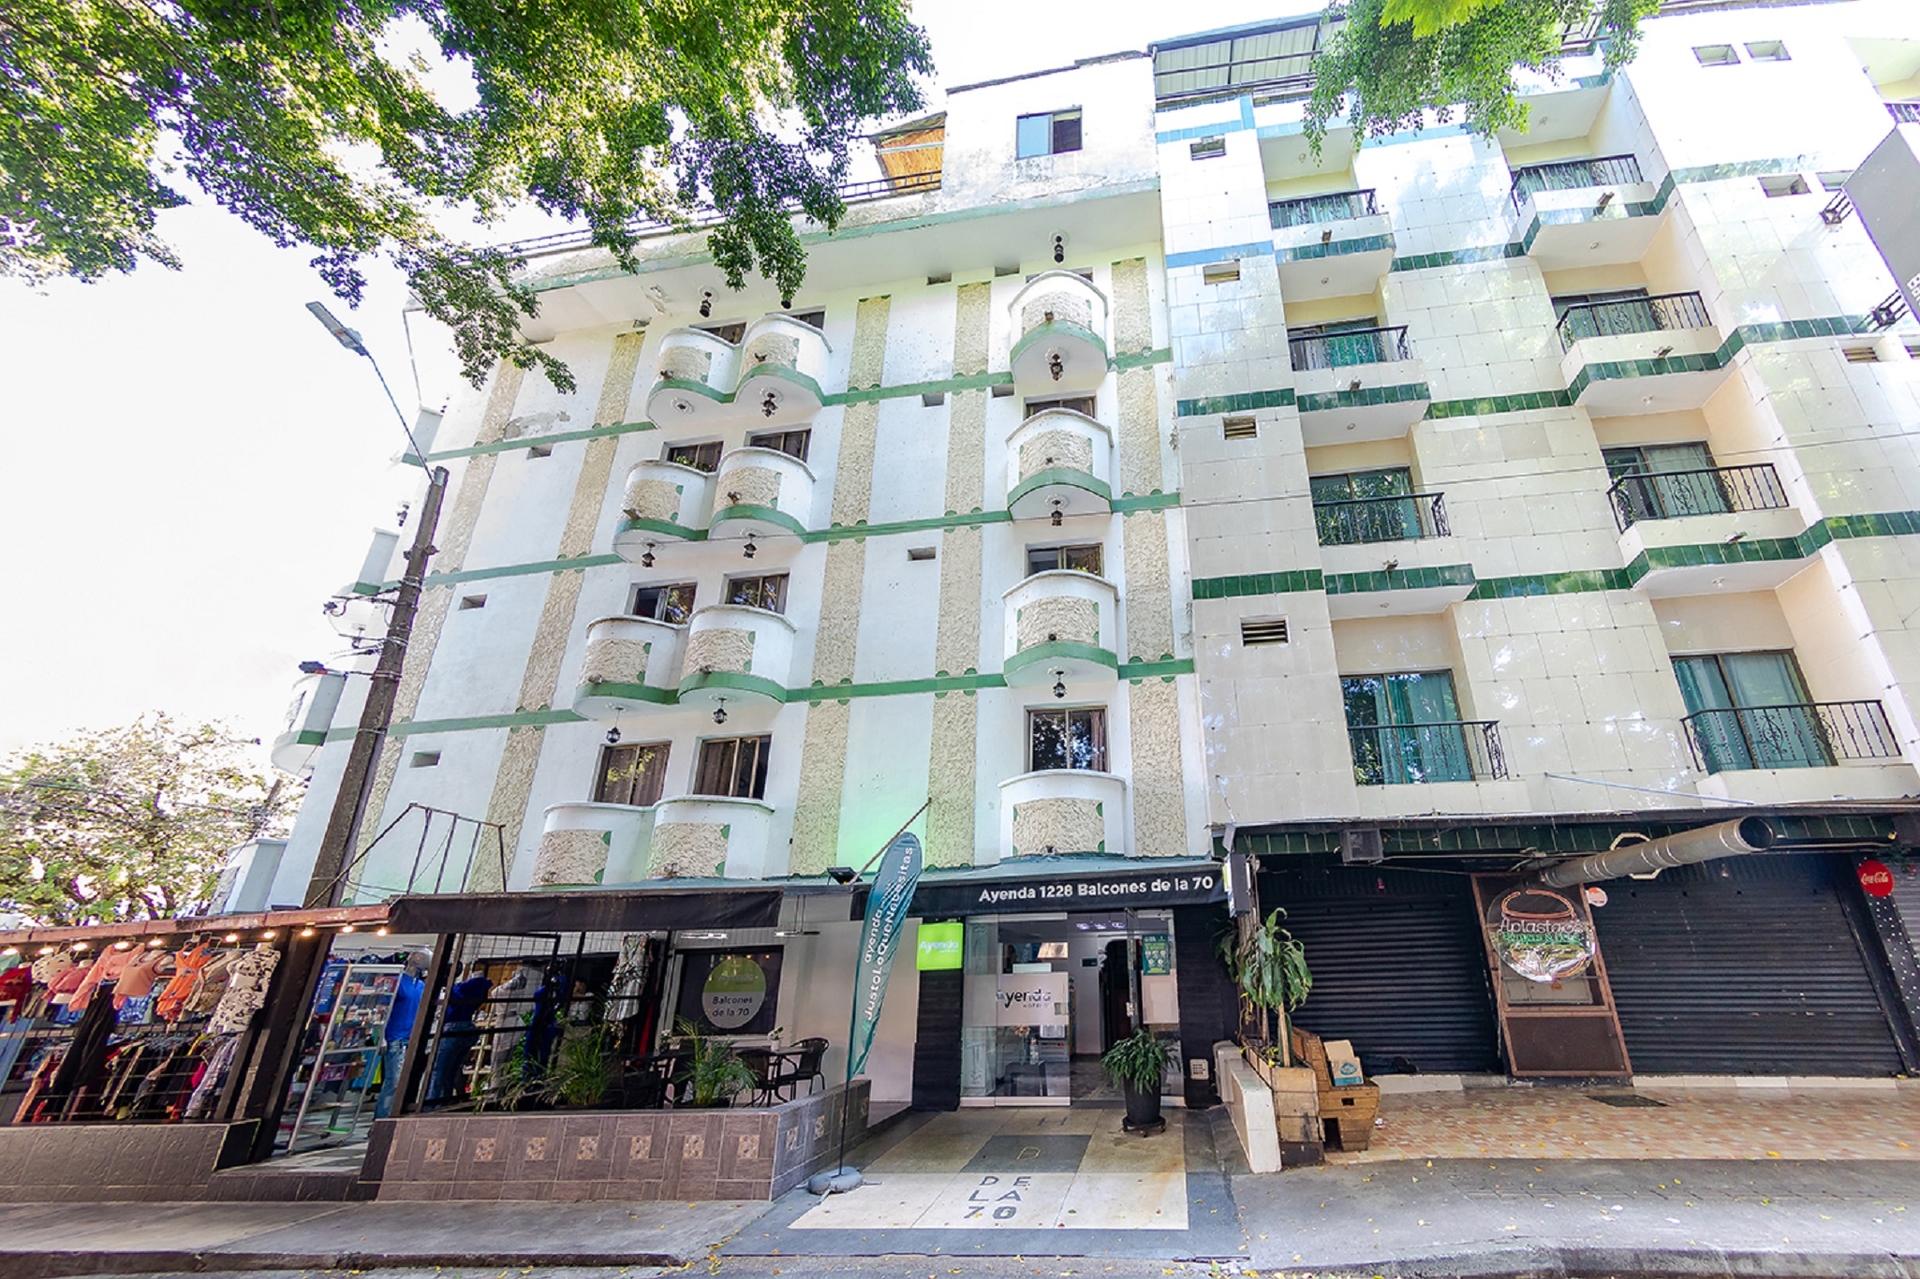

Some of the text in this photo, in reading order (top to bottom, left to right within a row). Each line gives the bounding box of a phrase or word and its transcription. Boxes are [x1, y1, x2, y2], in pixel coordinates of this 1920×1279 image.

[979, 876, 1213, 903] Ayenda 1228 Balcones de la 70
[864, 909, 882, 963] ayenda
[919, 940, 959, 954] Ayenda
[712, 995, 753, 1005] Balcones
[712, 1007, 750, 1017] de la 70
[979, 1175, 1032, 1187] DE
[968, 1189, 1022, 1202] LA
[963, 1205, 1018, 1220] 70
